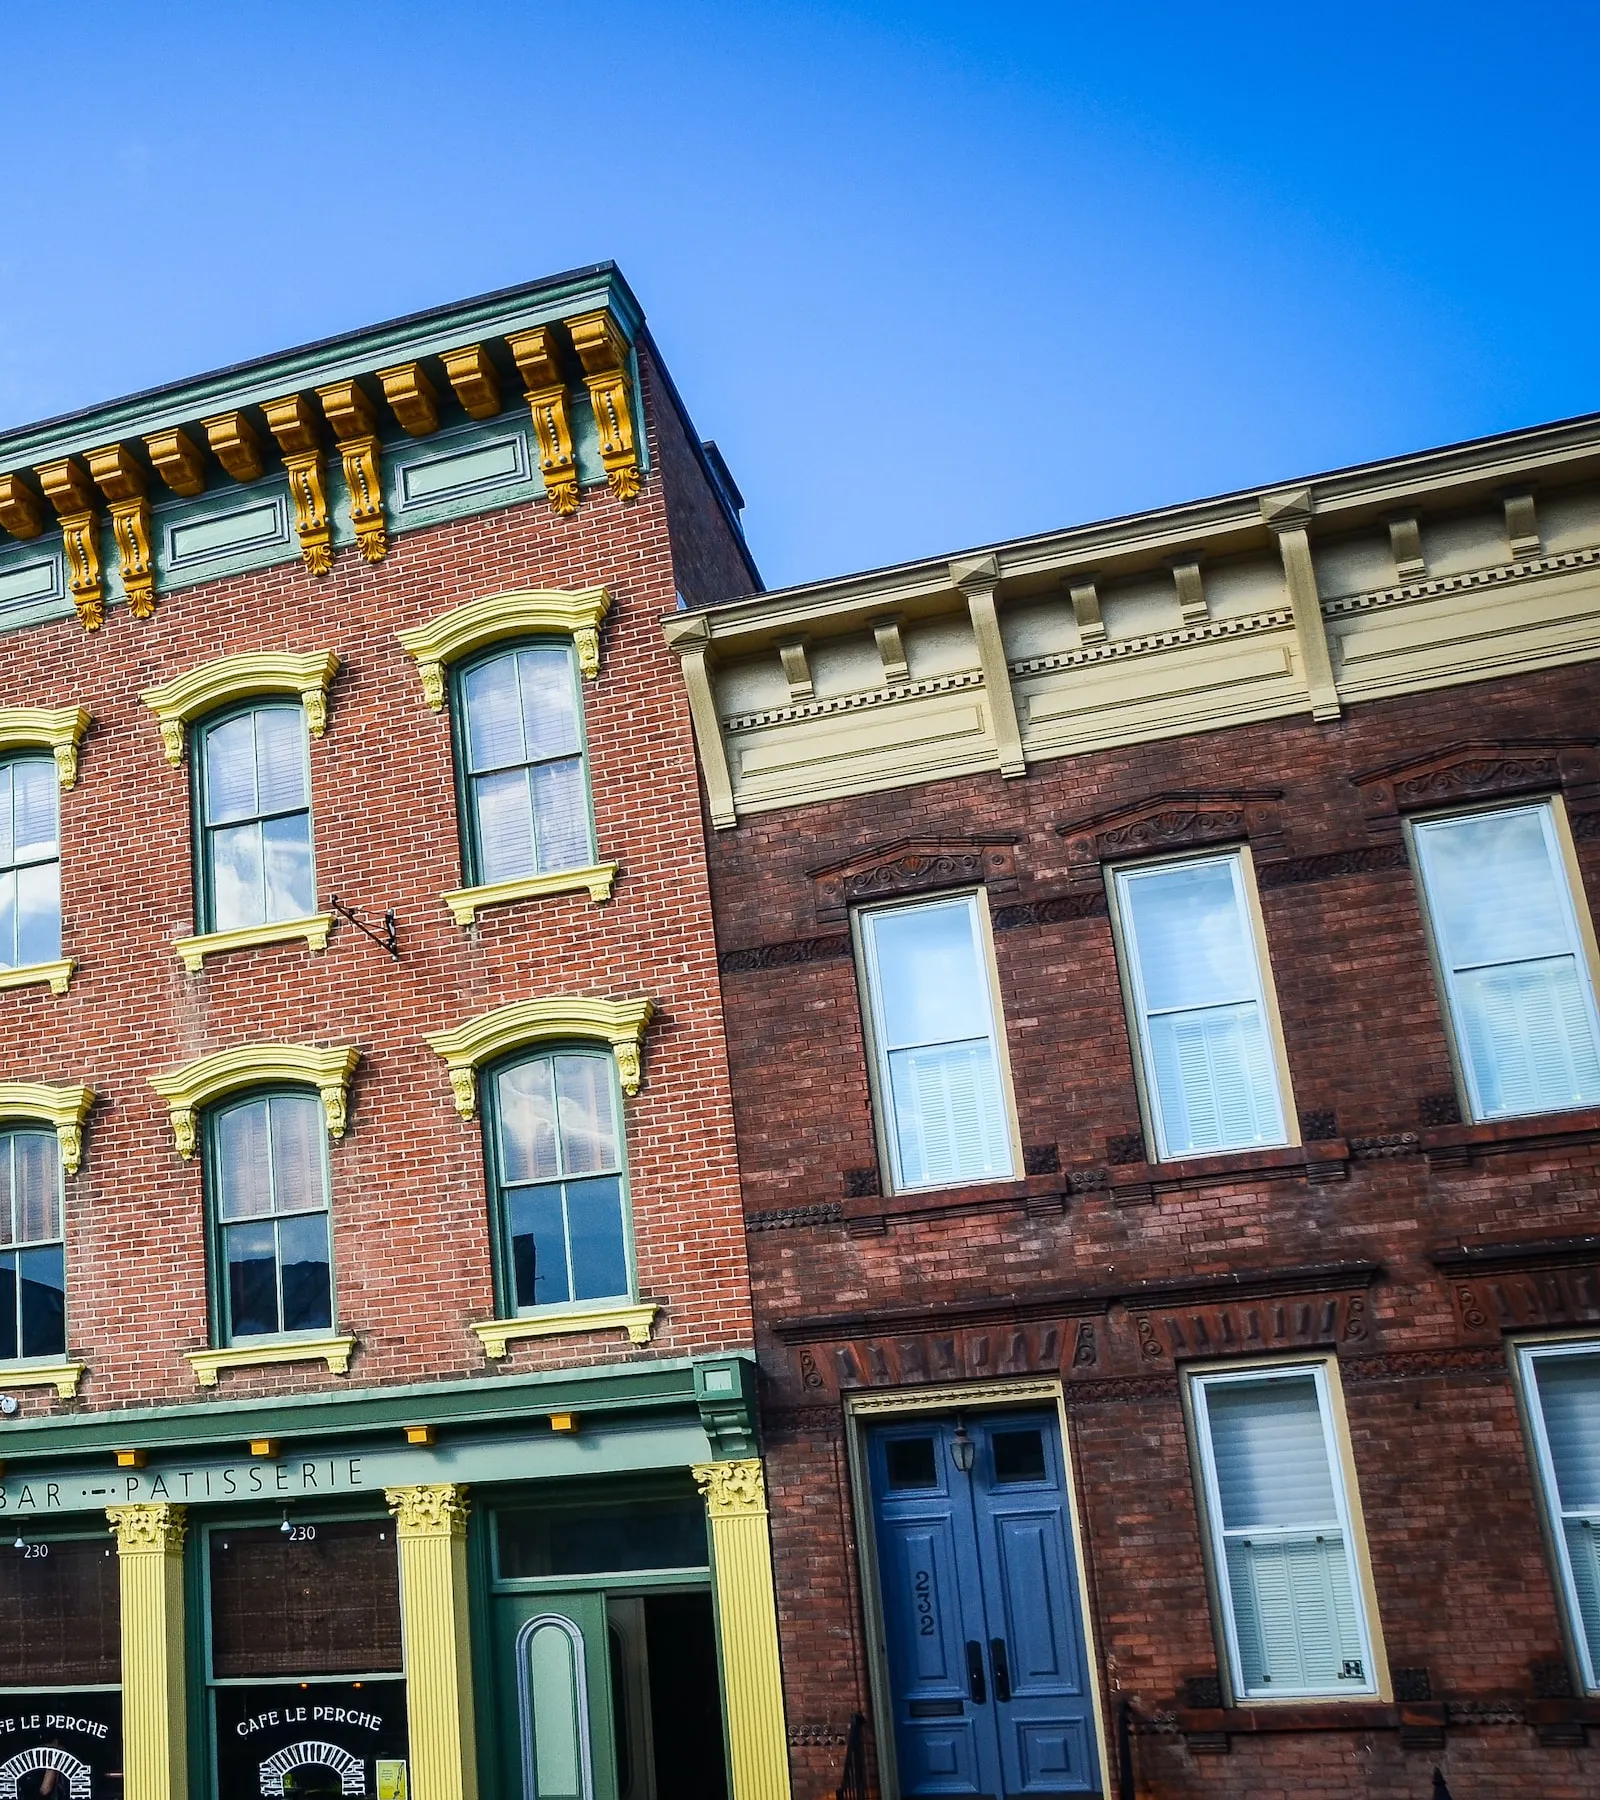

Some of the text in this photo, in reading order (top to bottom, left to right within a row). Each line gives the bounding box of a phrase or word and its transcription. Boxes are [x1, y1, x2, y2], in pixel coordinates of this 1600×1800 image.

[126, 1458, 363, 1502] PATISSERIE
[288, 1526, 316, 1541] 230
[24, 1544, 49, 1558] 230
[915, 1570, 935, 1636] 232
[21, 1715, 41, 1730] LE
[46, 1715, 109, 1739] PERCHE
[237, 1706, 383, 1736] CAFE LE PERCHE
